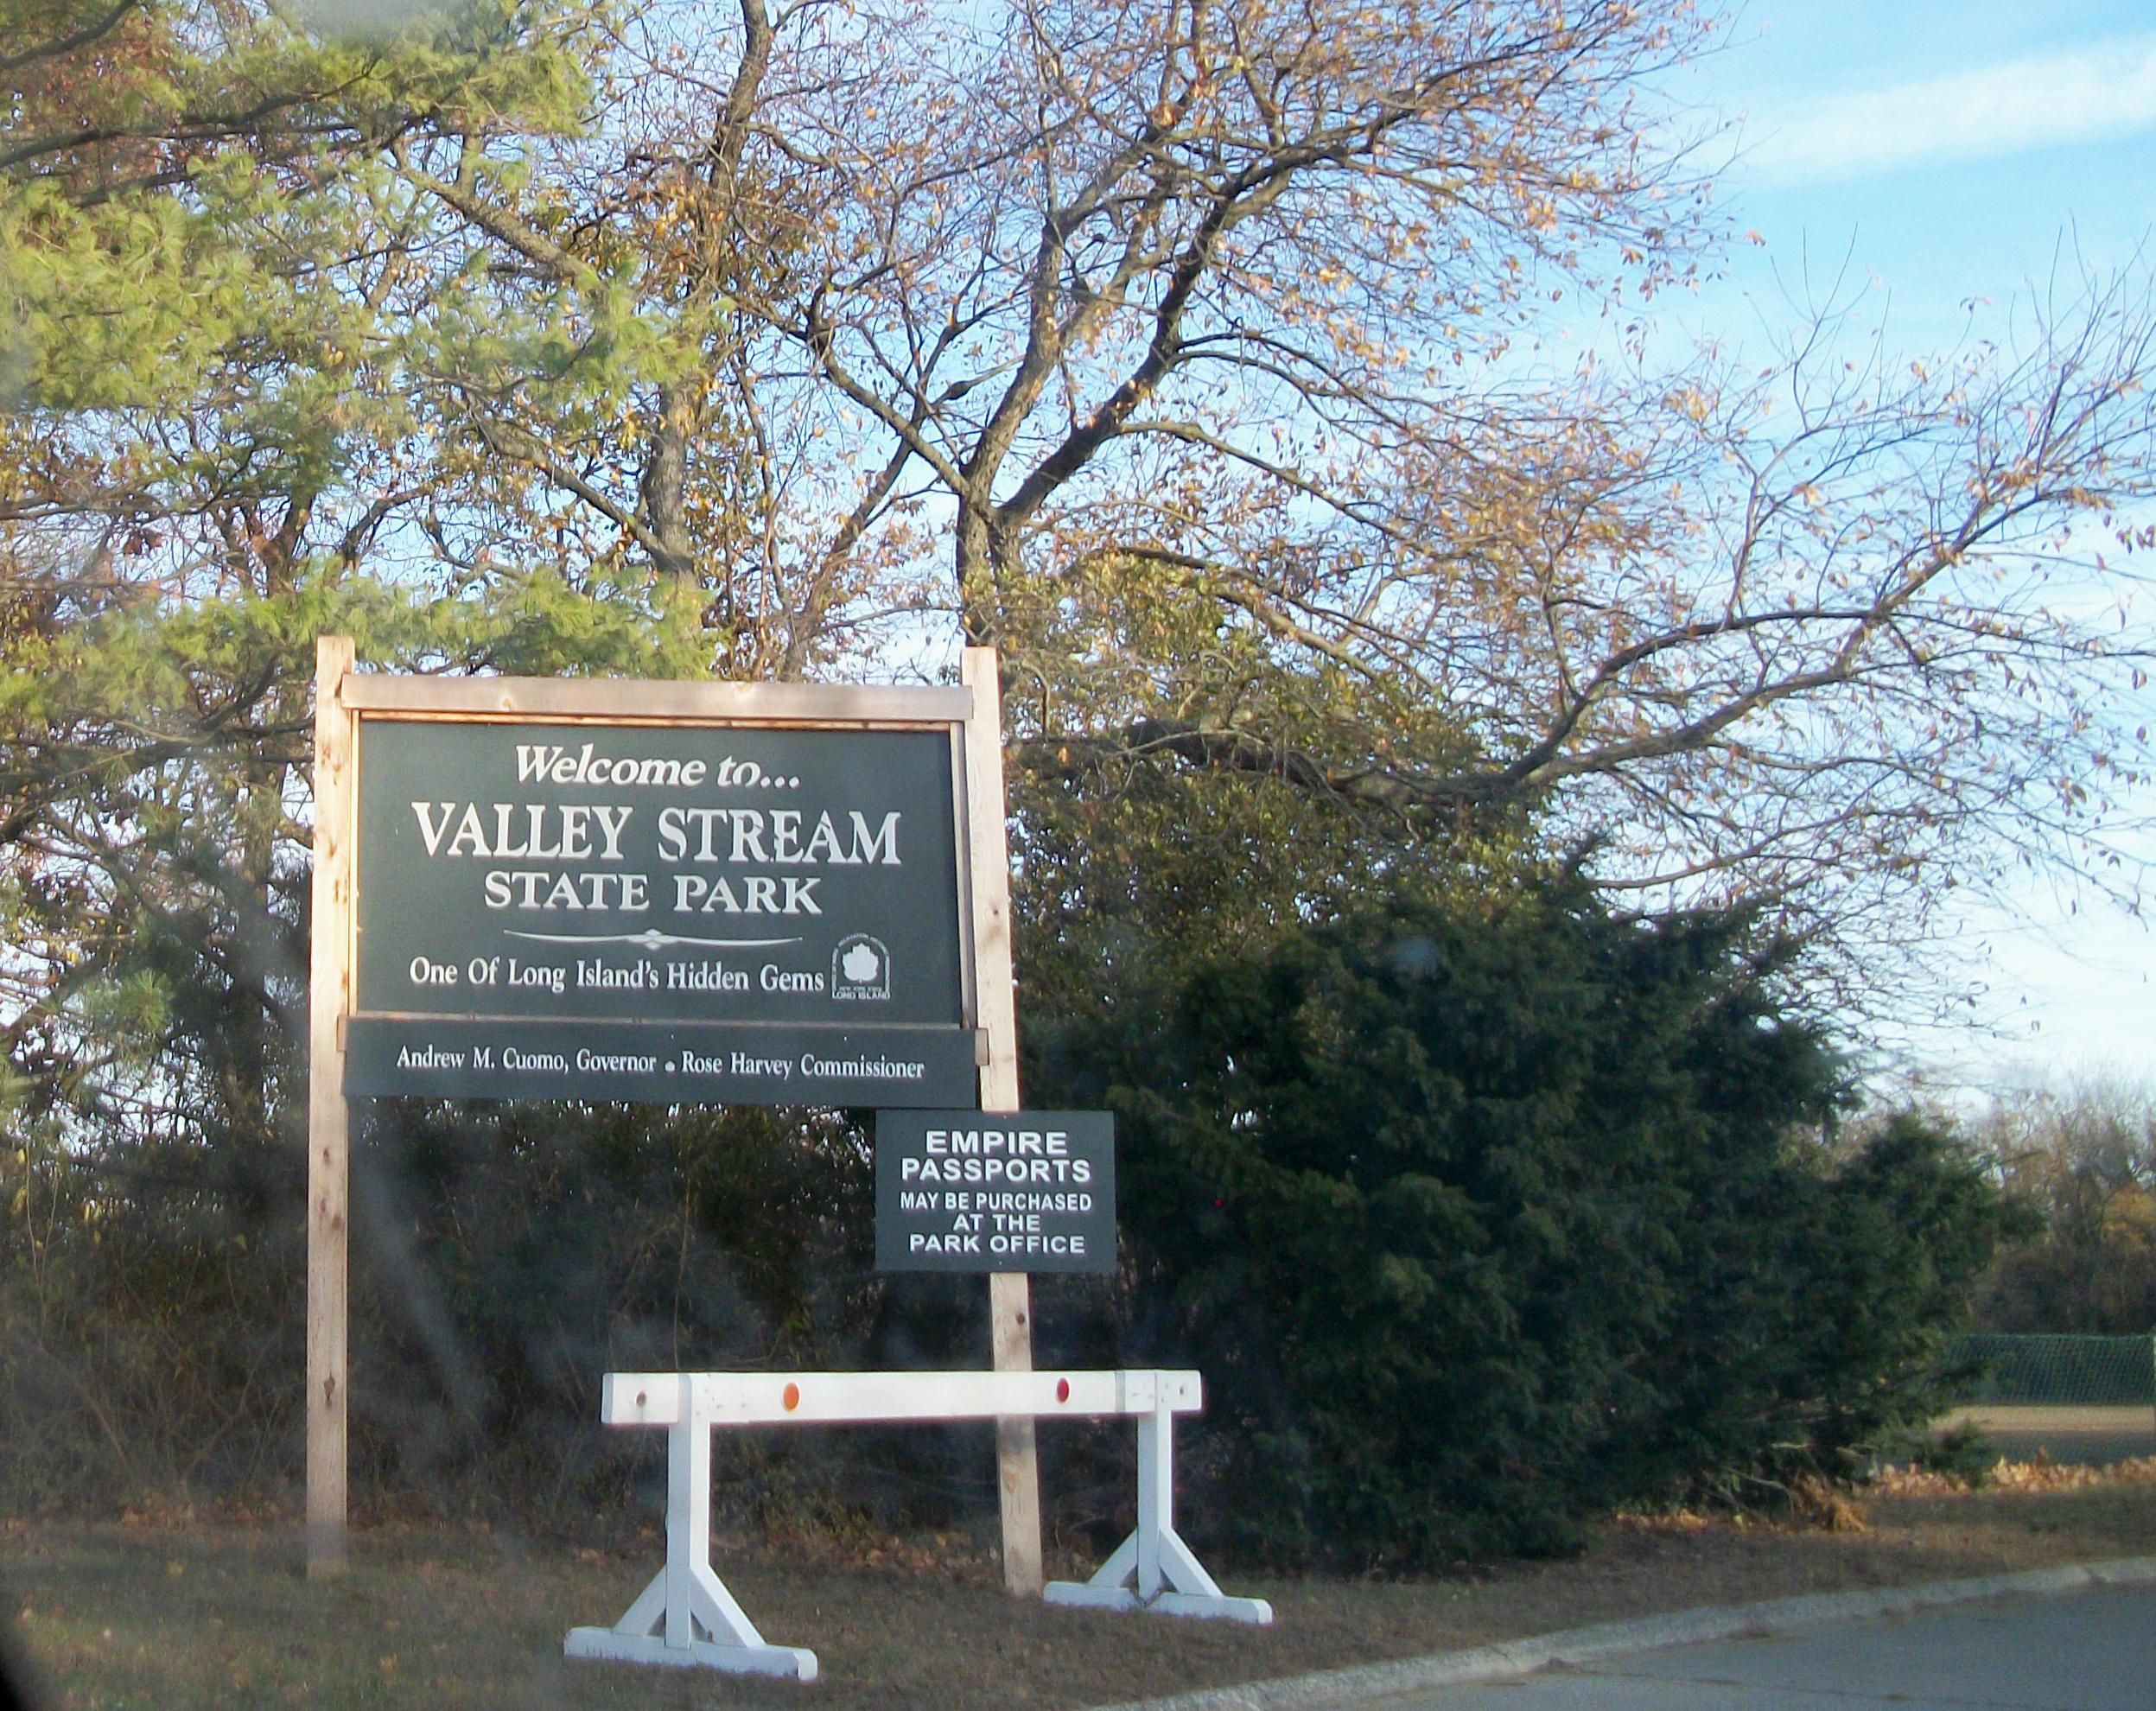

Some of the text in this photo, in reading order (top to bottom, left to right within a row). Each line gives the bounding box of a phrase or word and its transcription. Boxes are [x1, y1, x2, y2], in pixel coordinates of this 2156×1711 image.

[514, 743, 800, 789] Welcome to...
[411, 800, 902, 866] VALLEY STREAM
[484, 870, 824, 916] STATE PARK
[410, 956, 825, 992] One Of Long Island's Hidden Gems
[396, 1044, 925, 1080] Andrew M. Cuomo, Governor Rose Harvey Commissioner
[925, 1130, 1068, 1156] EMPIRE
[900, 1157, 1091, 1183] PASSPORTS
[900, 1191, 1092, 1212] MAY BE PURCHASED
[952, 1213, 1041, 1233] AT THE
[909, 1233, 1086, 1255] PARK OFFICE
